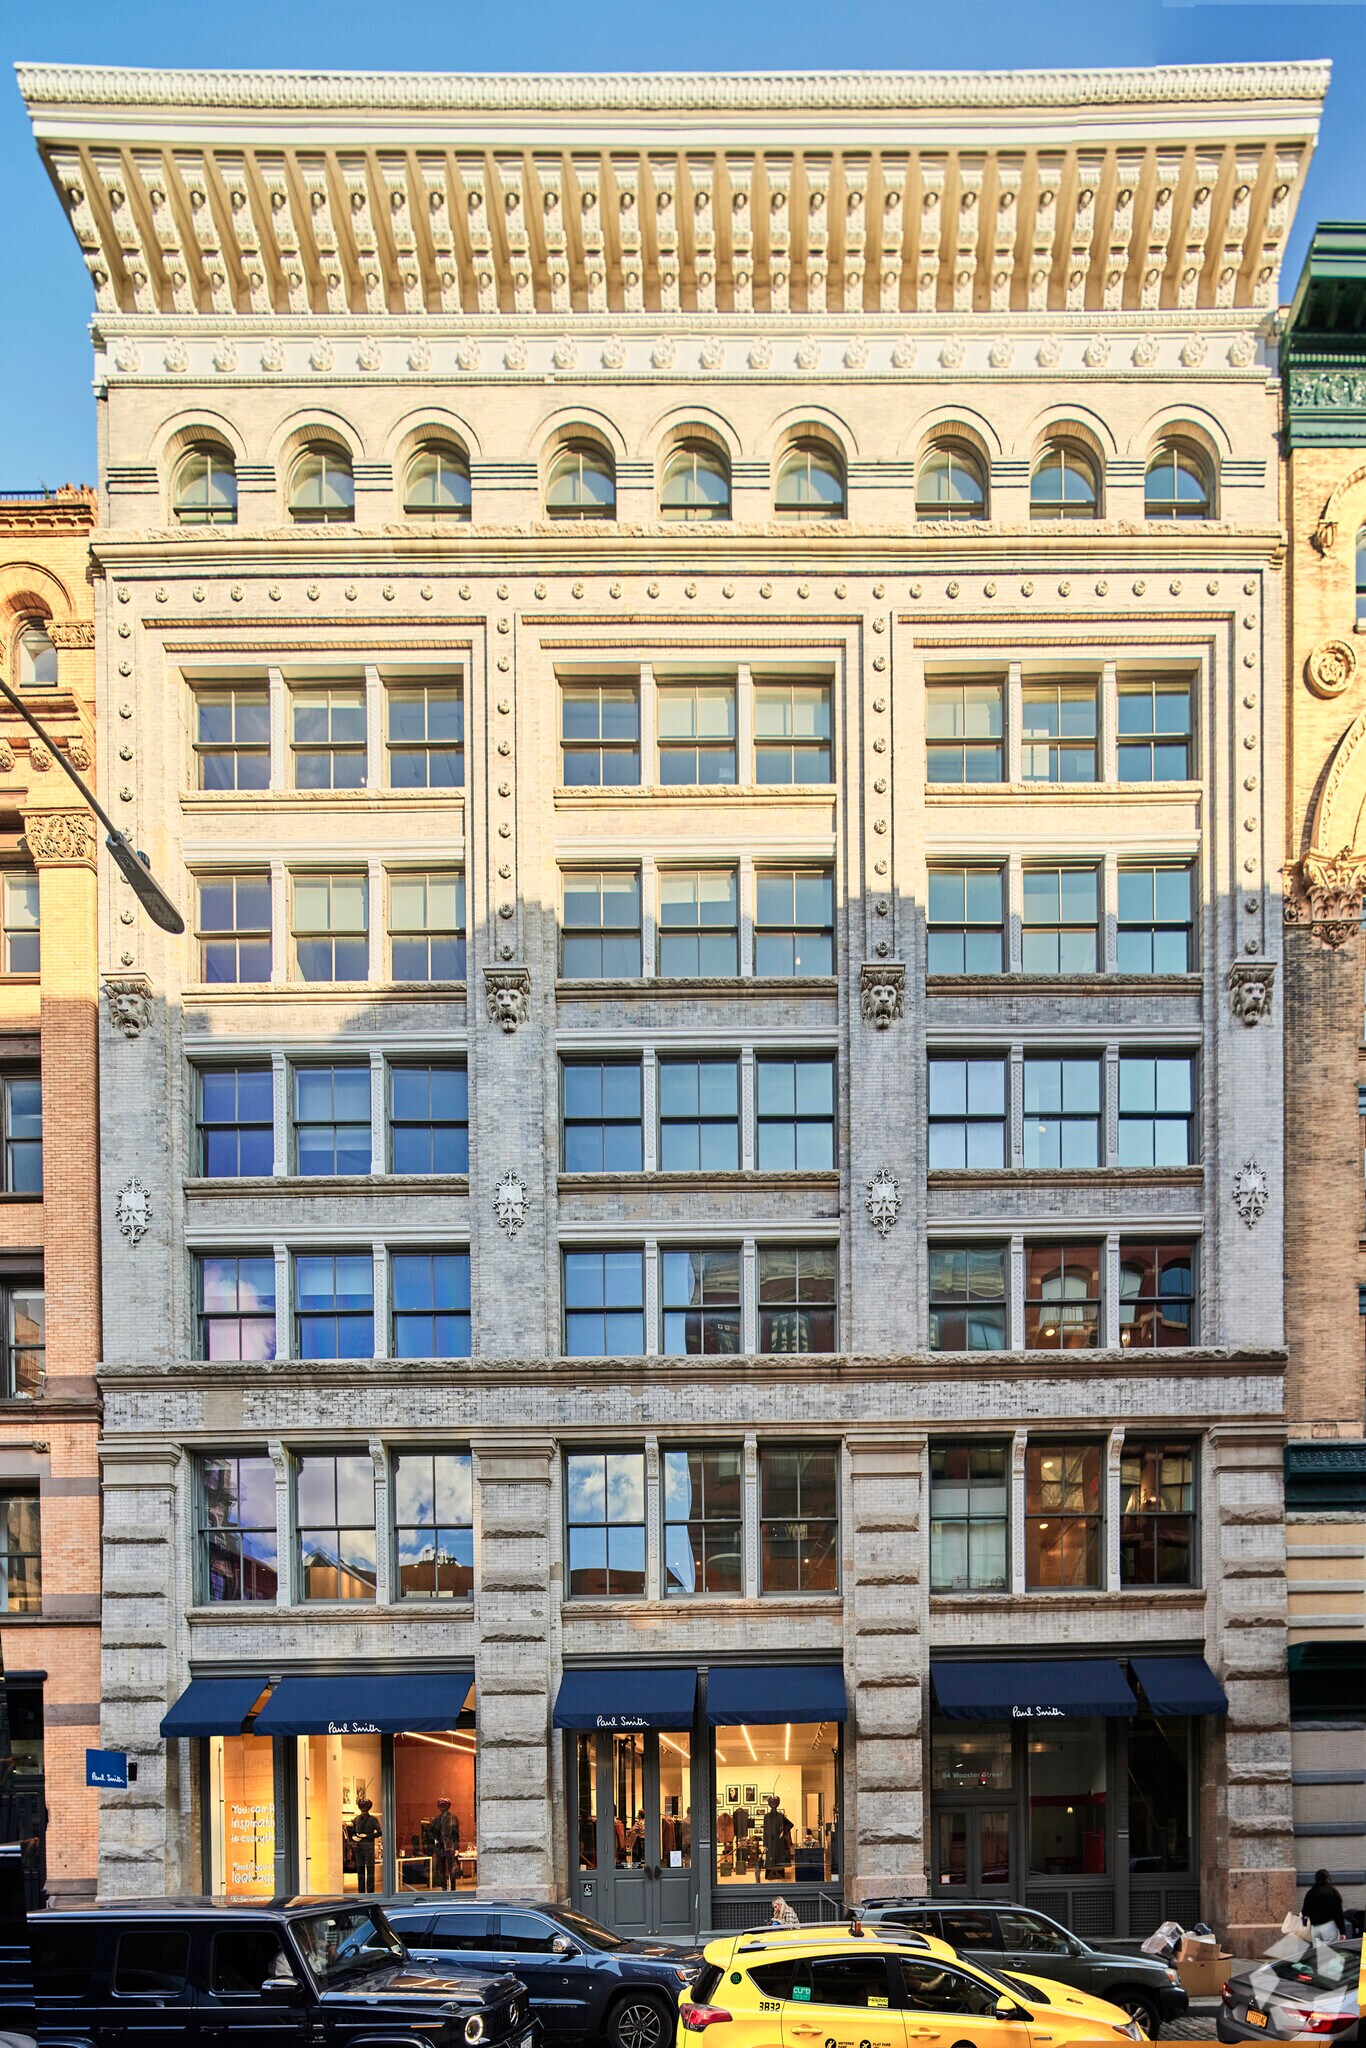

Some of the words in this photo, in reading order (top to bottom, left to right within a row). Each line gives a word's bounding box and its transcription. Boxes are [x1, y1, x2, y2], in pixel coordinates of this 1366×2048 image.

[1012, 1705, 1034, 1718] Paul
[1035, 1706, 1066, 1716] Smith
[596, 1715, 618, 1727] Paul
[620, 1716, 650, 1726] Smith
[328, 1721, 350, 1734] Paul
[352, 1722, 382, 1733] Smith
[91, 1771, 105, 1781] Paul
[106, 1773, 125, 1784] Smith
[231, 1804, 247, 1814] You
[250, 1805, 266, 1813] can
[231, 1870, 254, 1883] look
[793, 1986, 811, 1995] curb
[759, 2001, 781, 2012] 3832
